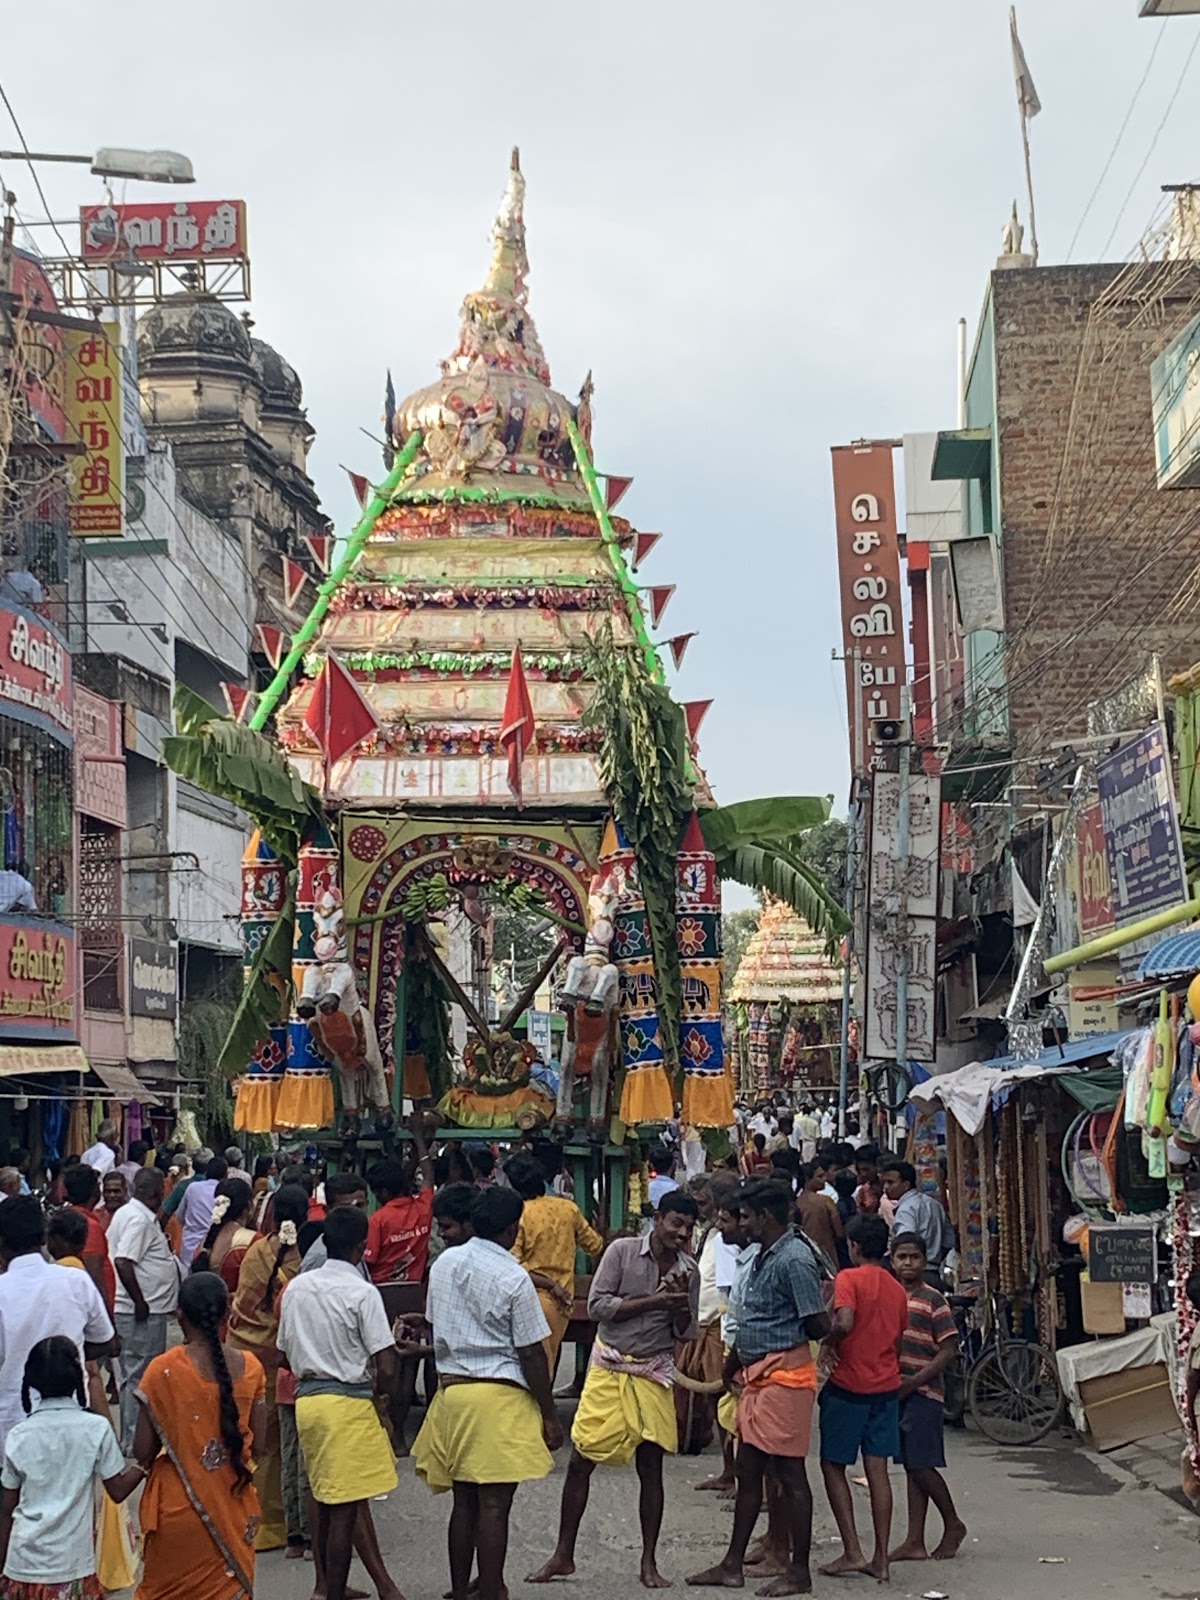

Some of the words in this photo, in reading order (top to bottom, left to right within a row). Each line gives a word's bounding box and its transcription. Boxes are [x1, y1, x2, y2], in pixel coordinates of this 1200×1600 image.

[850, 493, 895, 637] செல்வி
[10, 615, 64, 694] சிவந்தி
[10, 930, 67, 1000] சிவந்தி
